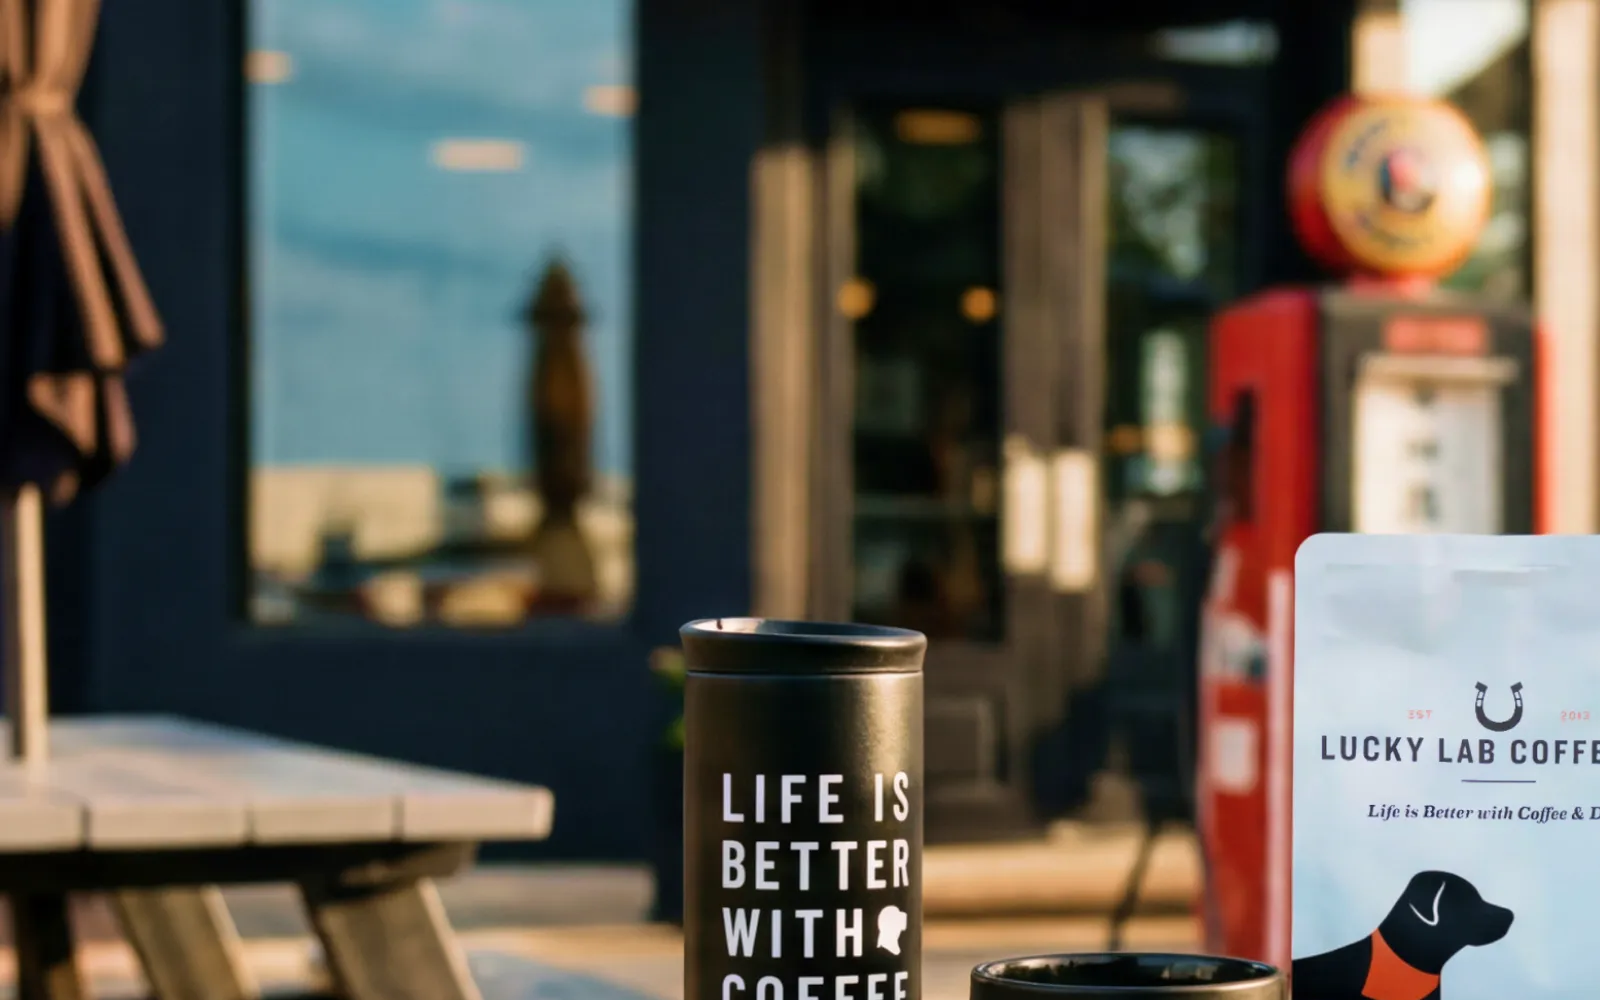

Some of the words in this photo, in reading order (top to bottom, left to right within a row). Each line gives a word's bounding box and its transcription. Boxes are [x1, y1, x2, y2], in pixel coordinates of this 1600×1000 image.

[1408, 709, 1432, 720] EST
[1321, 735, 1424, 763] LUCKY
[1438, 737, 1495, 764] LAB
[722, 772, 844, 824] LIFE
[873, 768, 909, 822] IS
[1368, 804, 1400, 821] Life
[1405, 804, 1418, 818] is
[1423, 804, 1474, 819] Better
[1477, 806, 1513, 820] with
[1517, 806, 1568, 824] Coffee
[1571, 806, 1584, 820] &
[722, 838, 910, 891] BETTER
[722, 907, 863, 958] WITH
